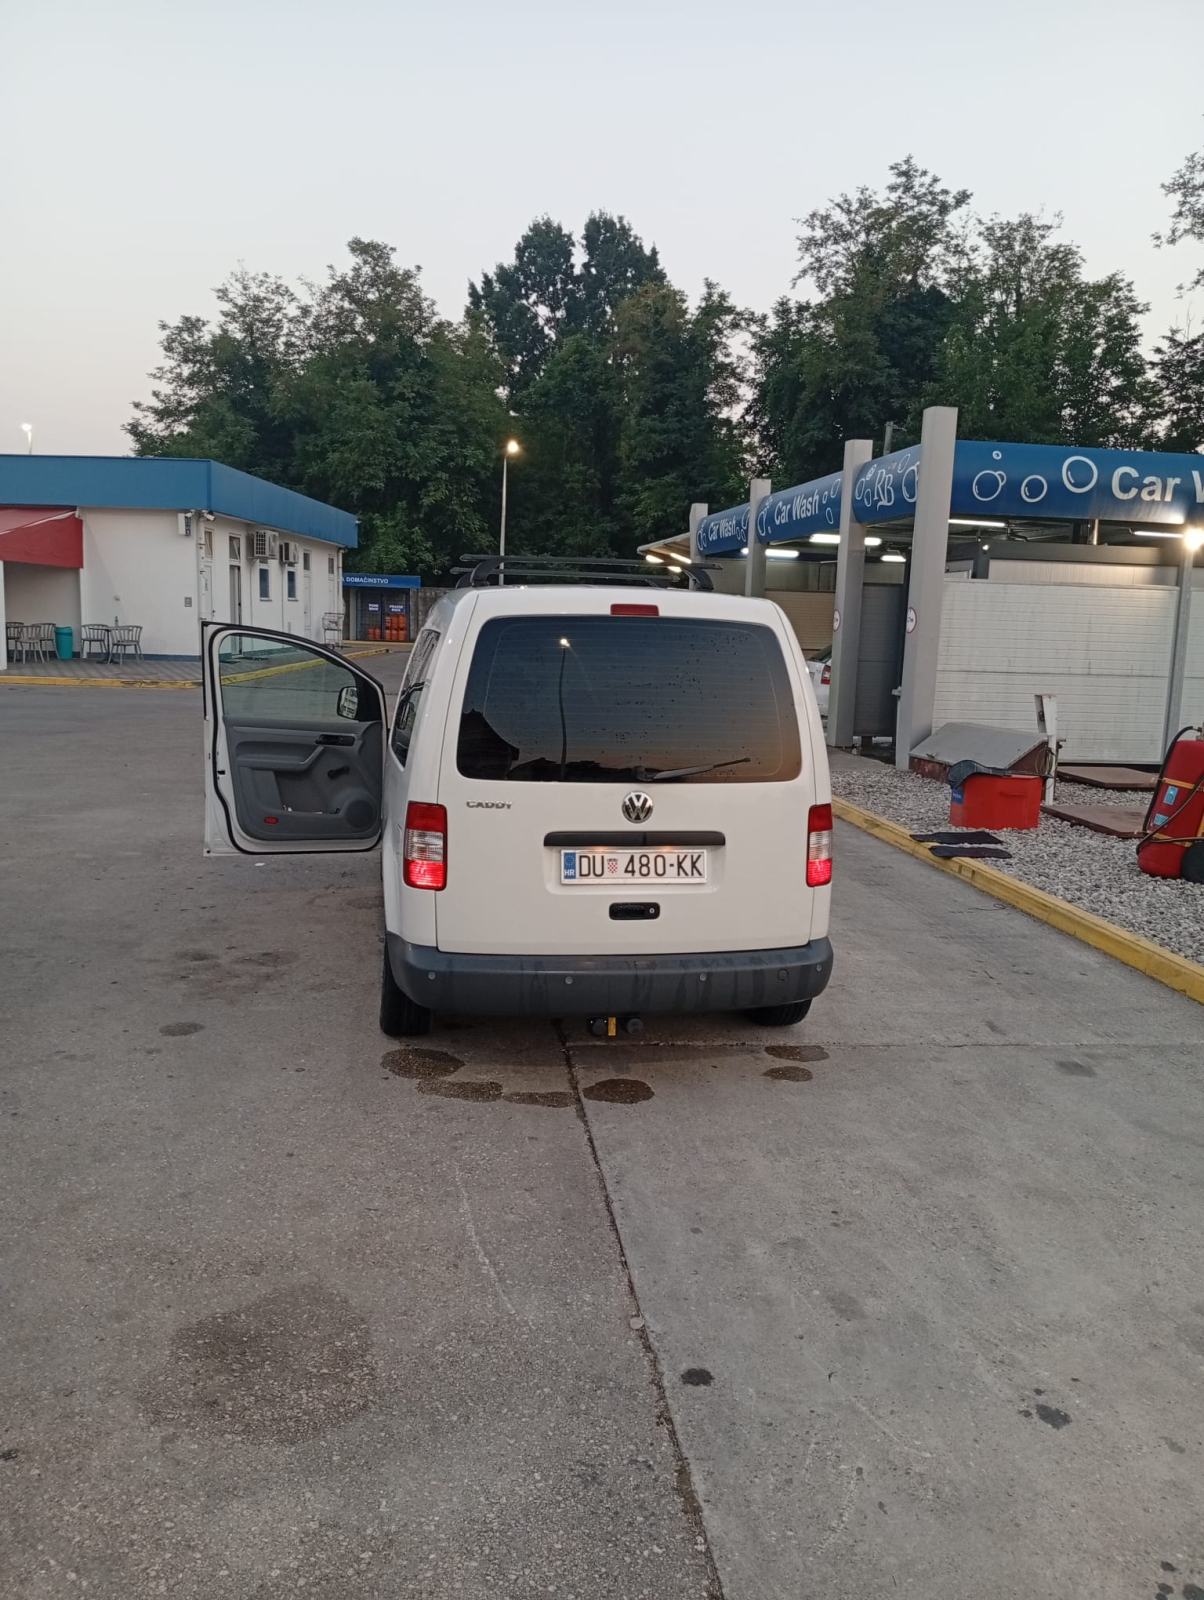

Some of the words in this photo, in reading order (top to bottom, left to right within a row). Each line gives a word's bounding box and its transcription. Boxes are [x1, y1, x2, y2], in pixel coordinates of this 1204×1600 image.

[1111, 466, 1182, 502] Car
[774, 500, 792, 526] Car
[792, 489, 819, 521] Wash
[708, 521, 720, 541] Car
[719, 516, 737, 539] Wash
[466, 801, 512, 809] CADDY
[564, 869, 575, 877] HR
[578, 854, 605, 877] DU
[624, 854, 703, 877] 480-KK
